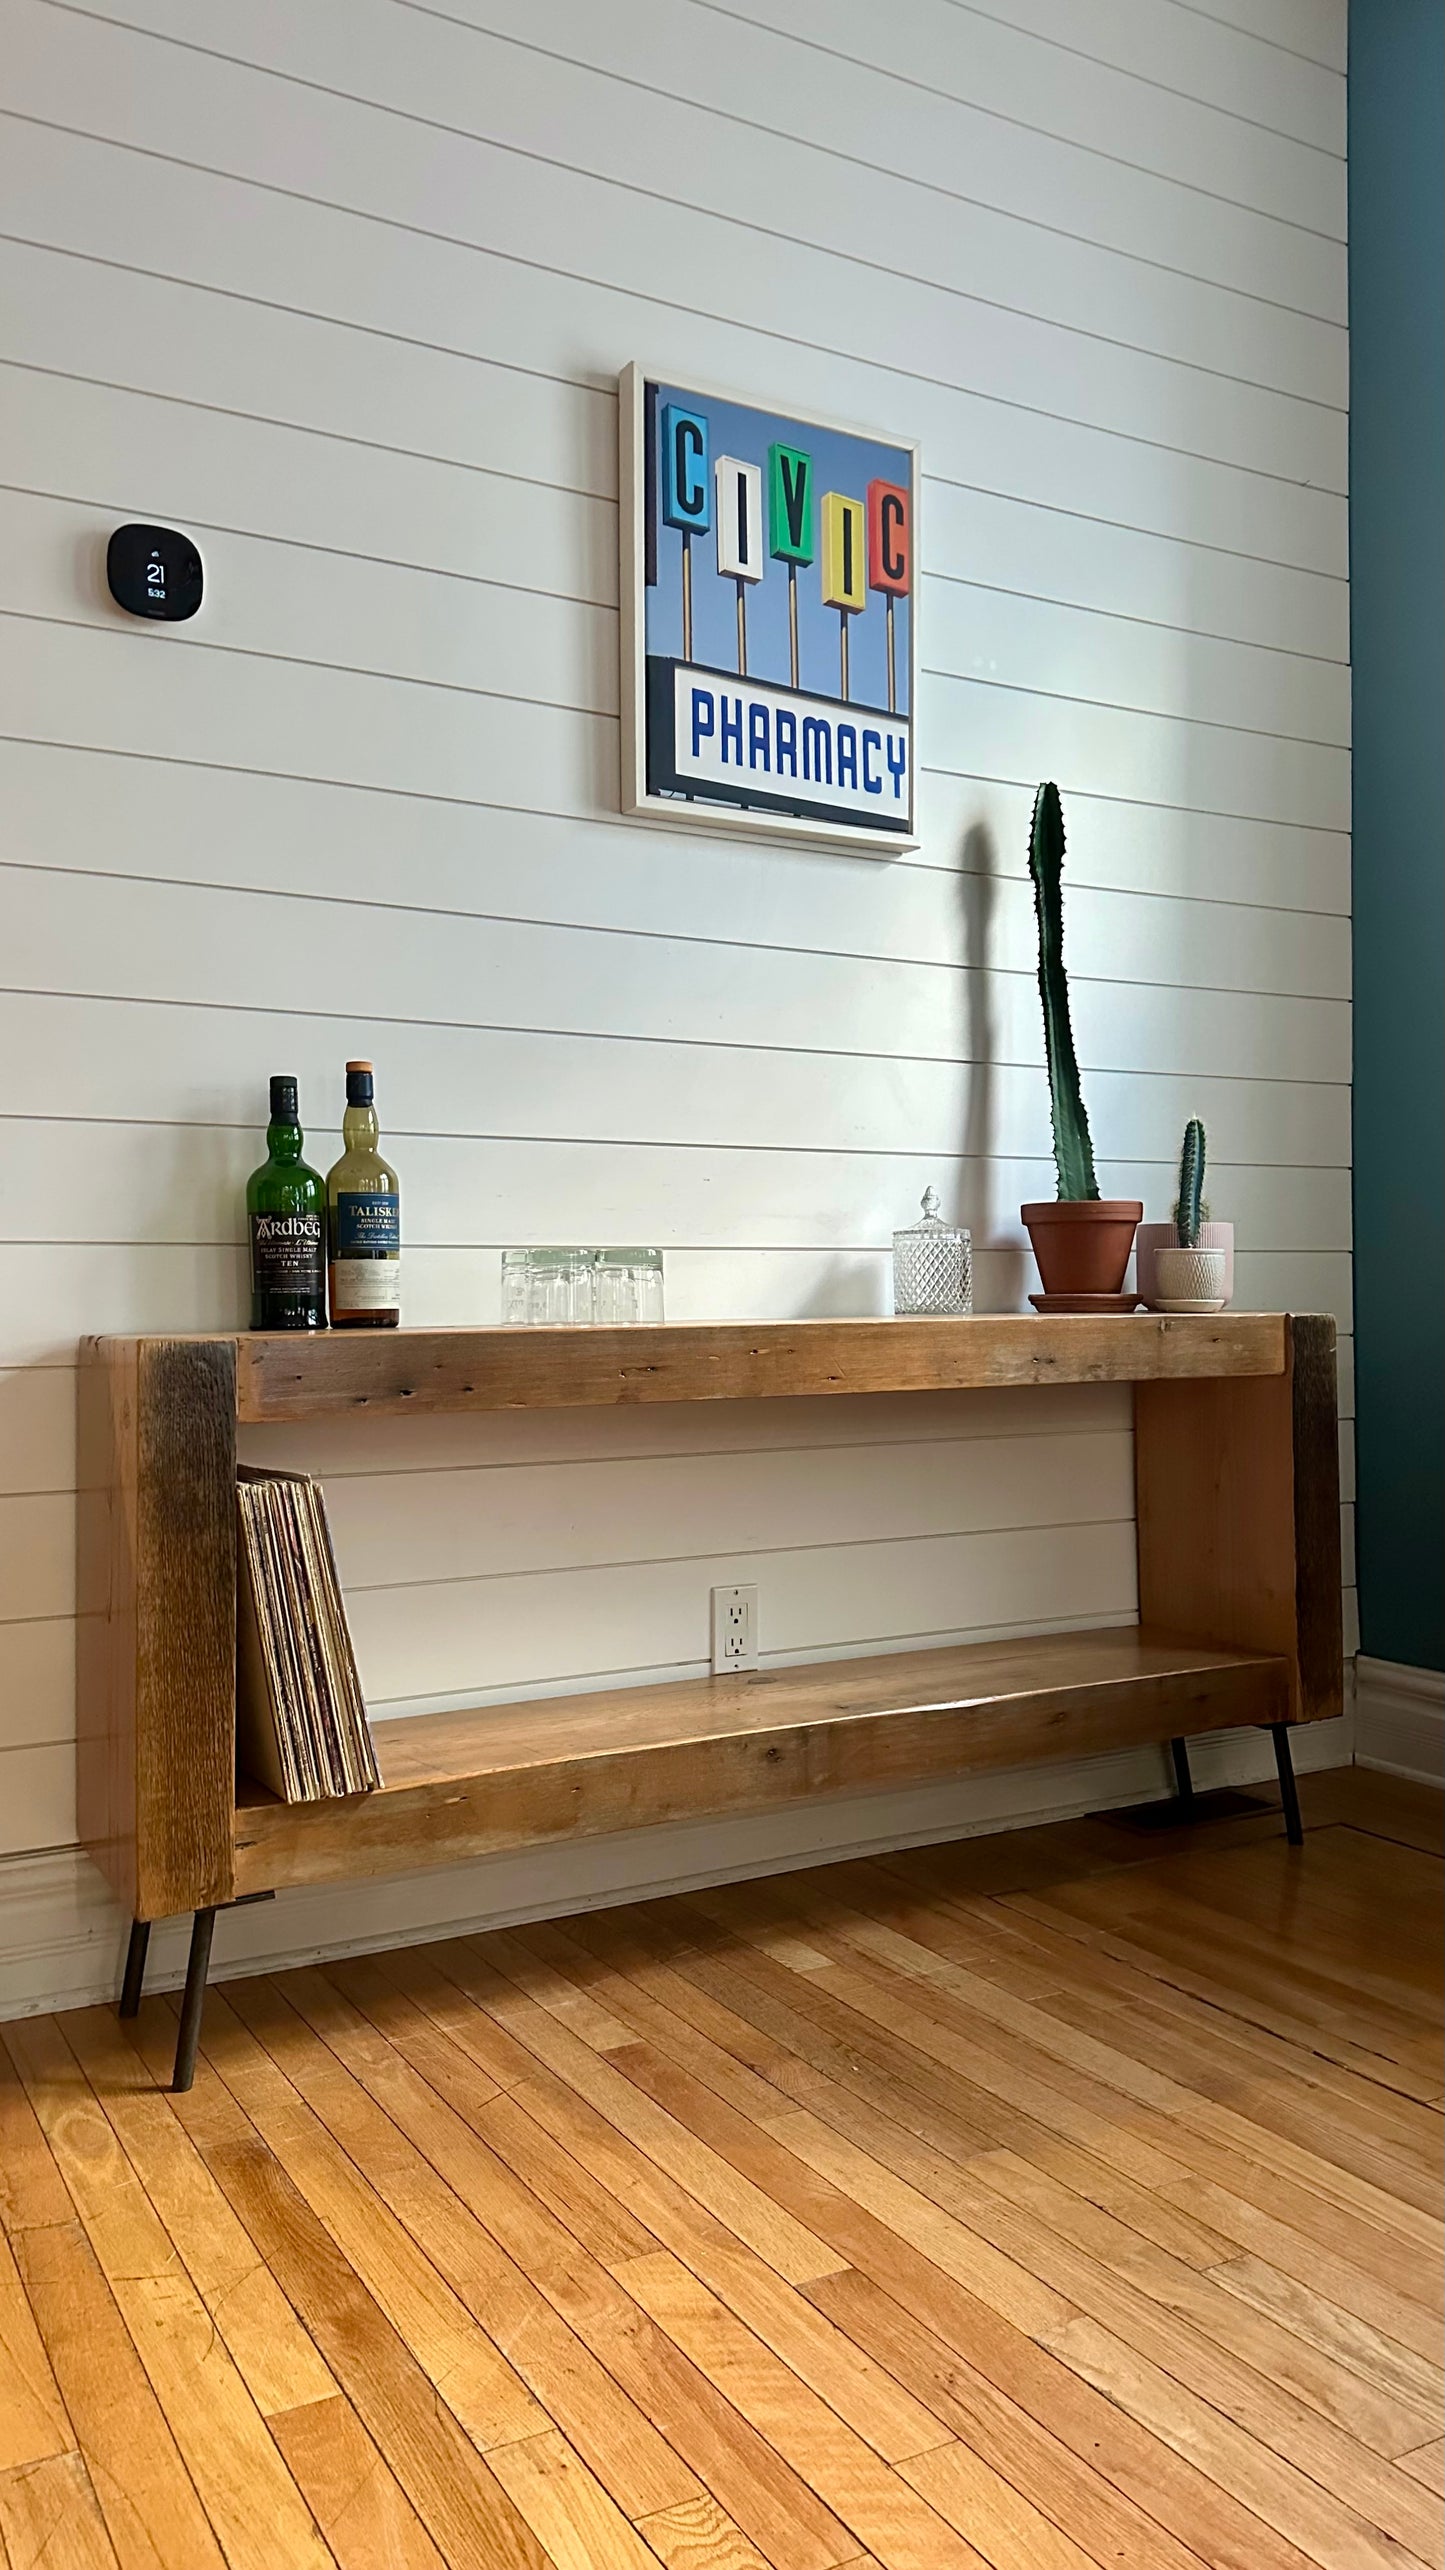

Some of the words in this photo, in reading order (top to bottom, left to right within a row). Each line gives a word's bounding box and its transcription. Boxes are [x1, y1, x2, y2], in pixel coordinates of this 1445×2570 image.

[675, 418, 905, 597] CIVIC
[147, 563, 165, 584] 21
[691, 687, 907, 800] PHARMACY
